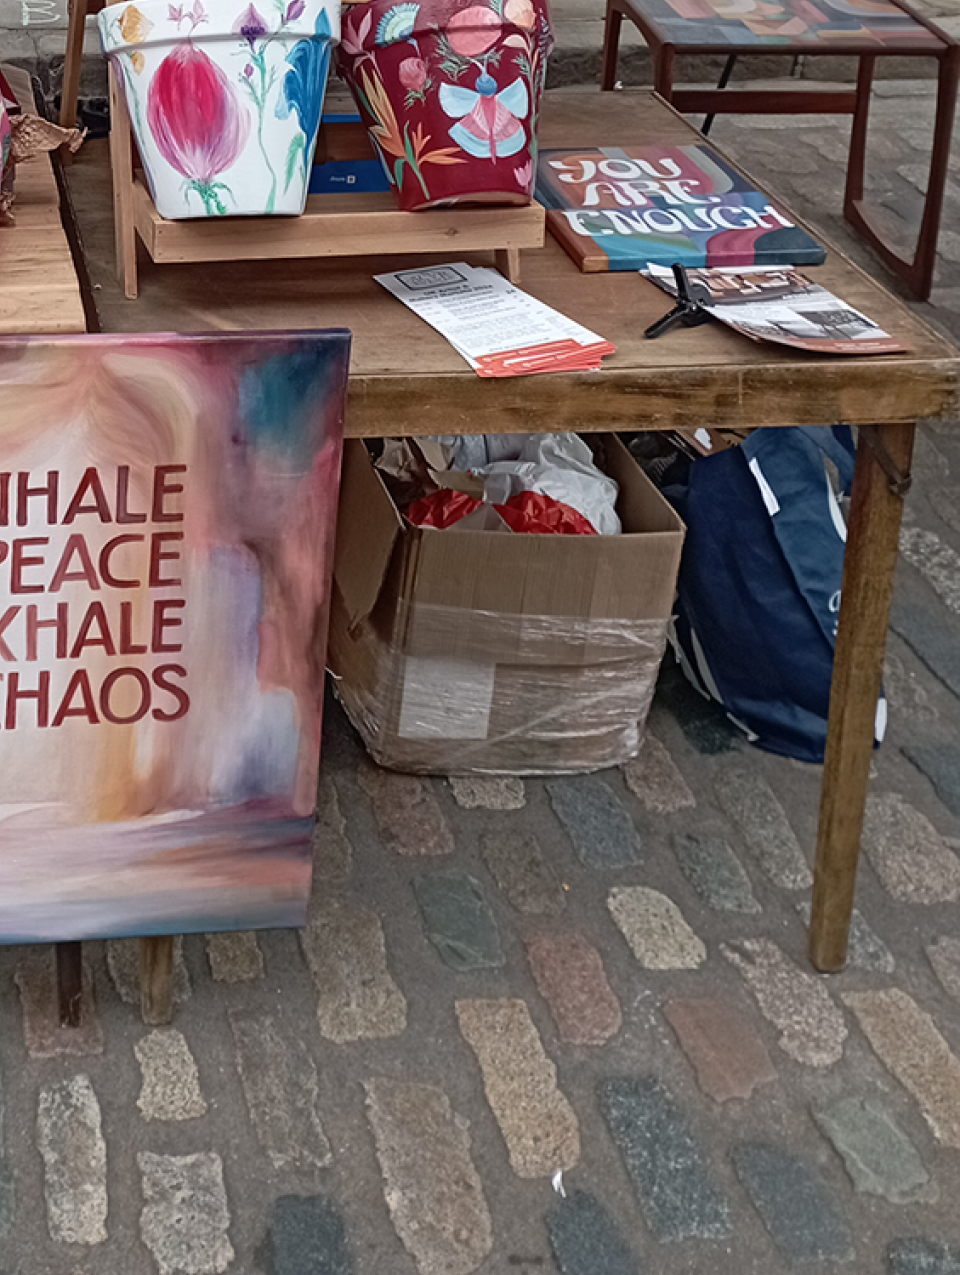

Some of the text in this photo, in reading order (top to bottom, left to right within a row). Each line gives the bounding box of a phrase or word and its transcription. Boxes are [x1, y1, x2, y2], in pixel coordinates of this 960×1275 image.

[548, 158, 682, 183] YOU
[582, 180, 721, 206] ARE
[562, 205, 796, 236] ENOUGH
